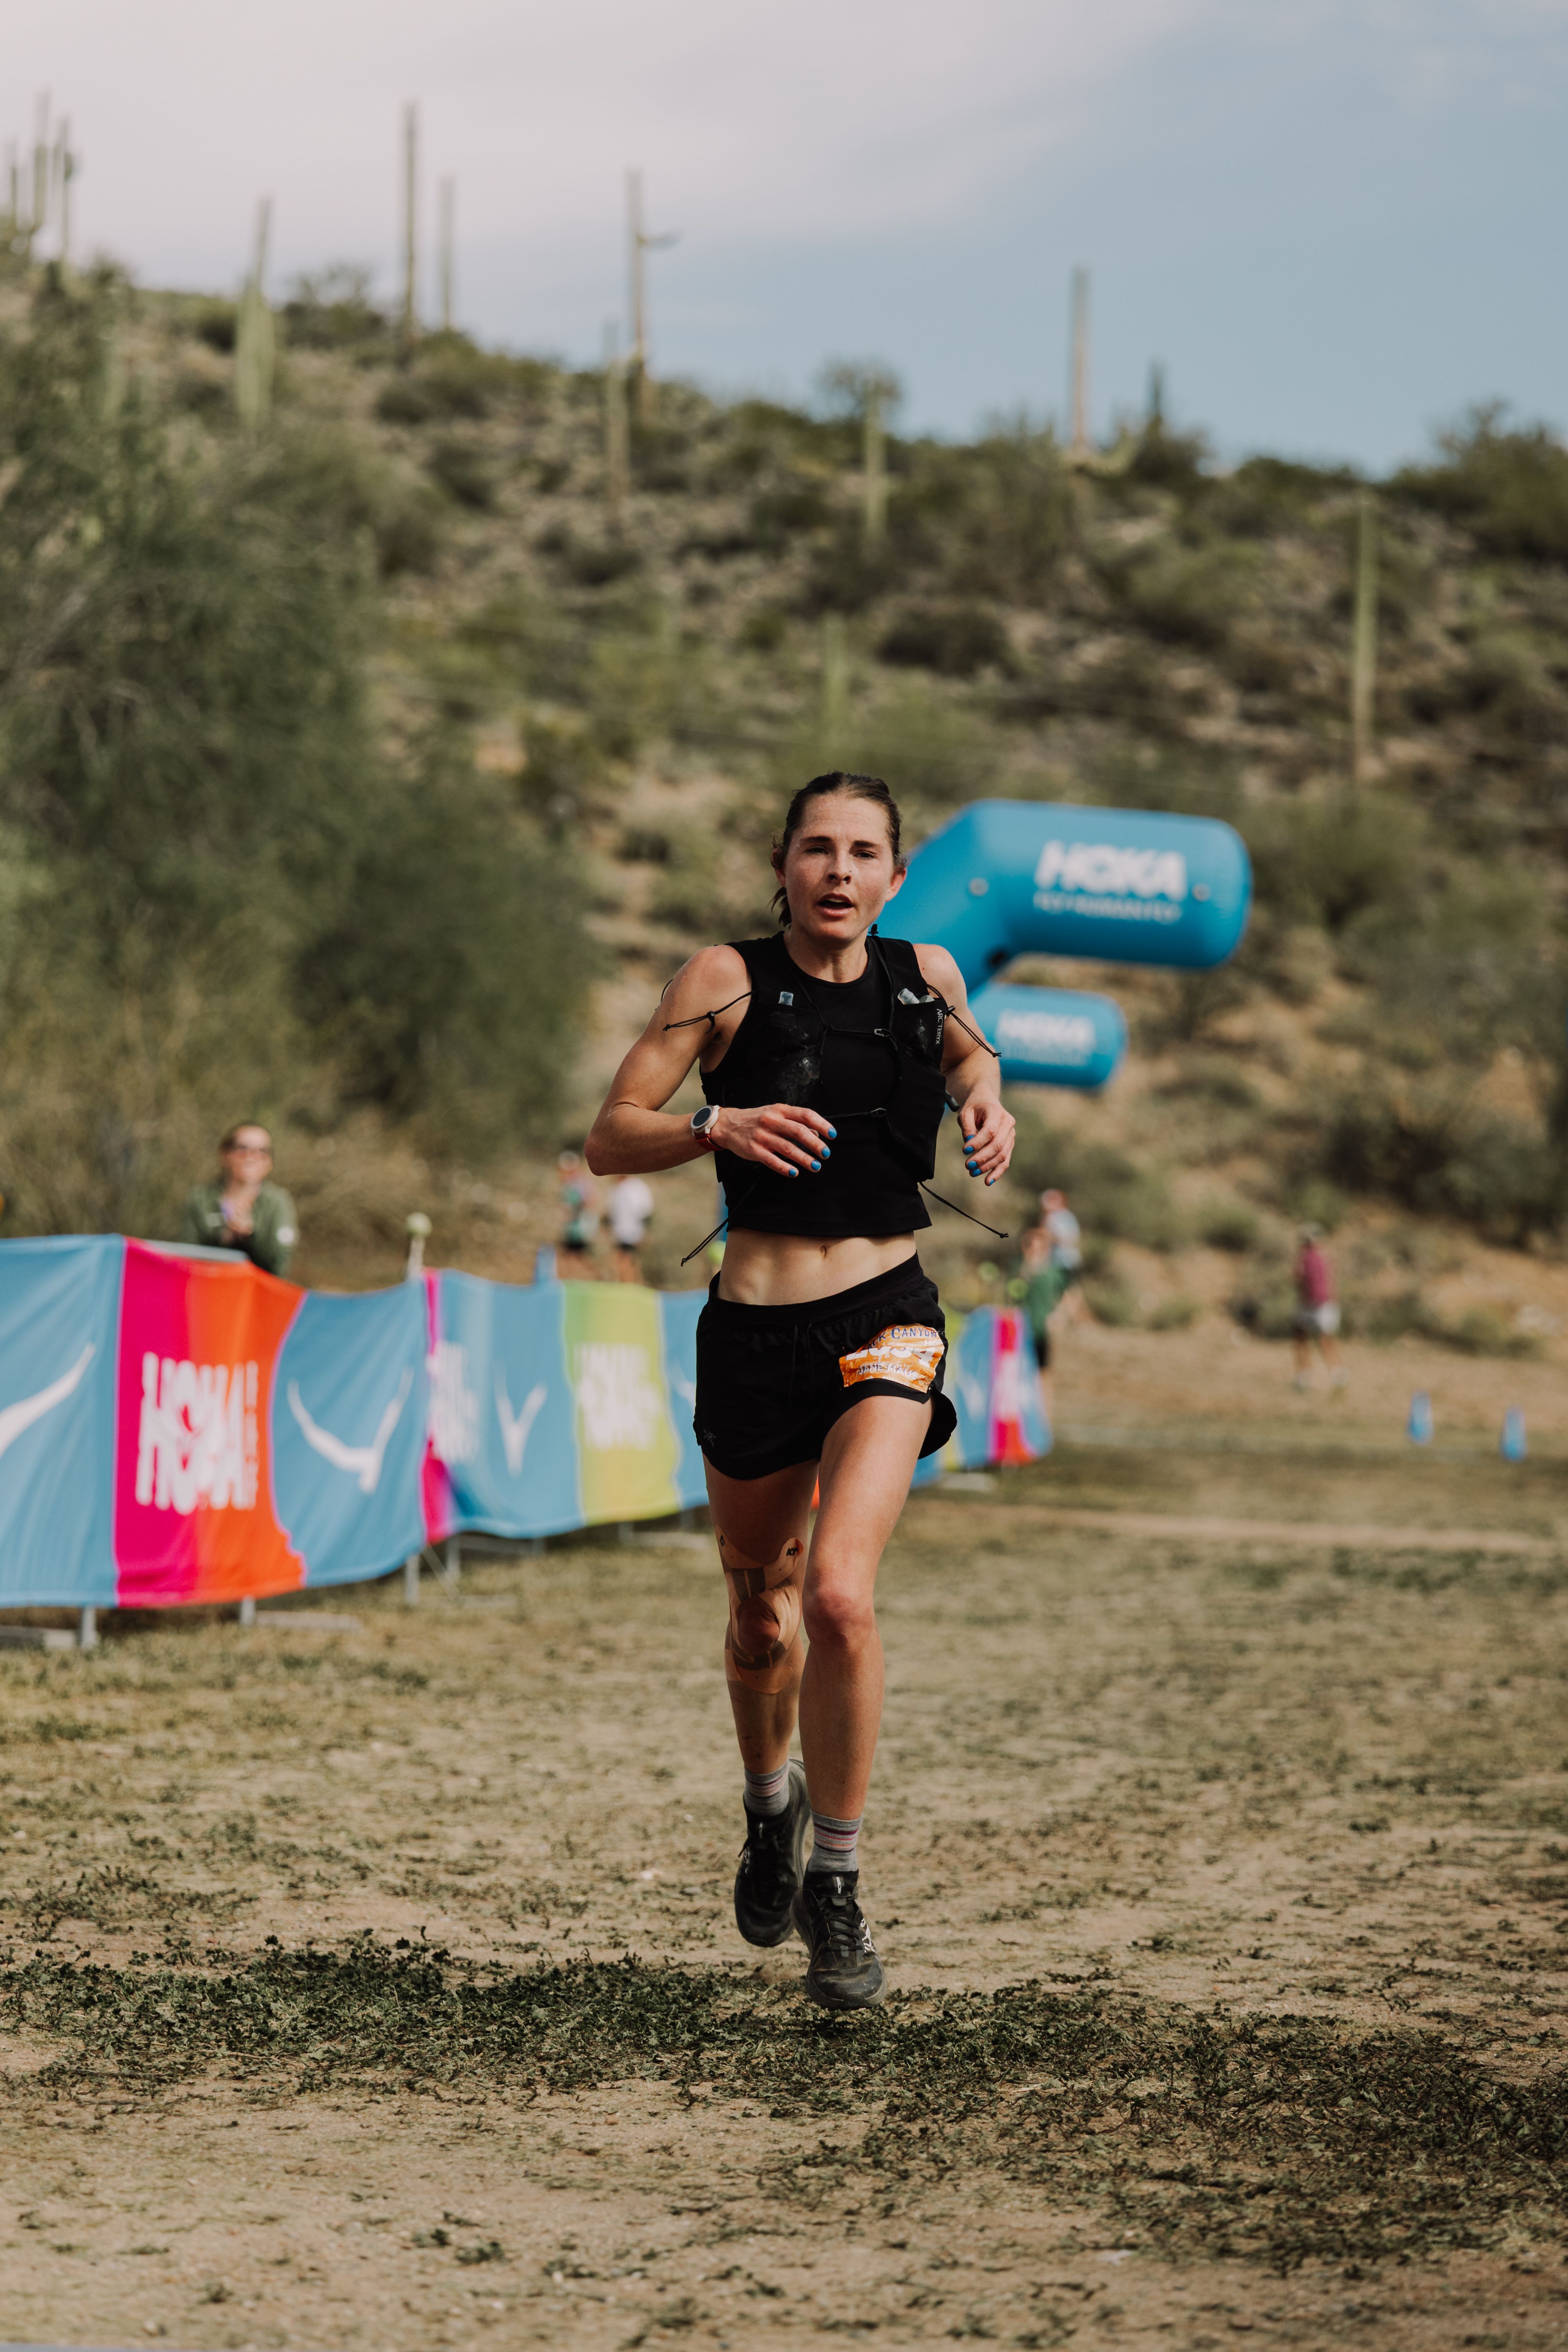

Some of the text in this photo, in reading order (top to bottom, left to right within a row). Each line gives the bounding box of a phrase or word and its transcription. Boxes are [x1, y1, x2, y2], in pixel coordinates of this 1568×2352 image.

[891, 1328, 937, 1339] CANYON
[859, 1362, 919, 1380] JANE MAUS
[786, 1548, 798, 1556] KT
